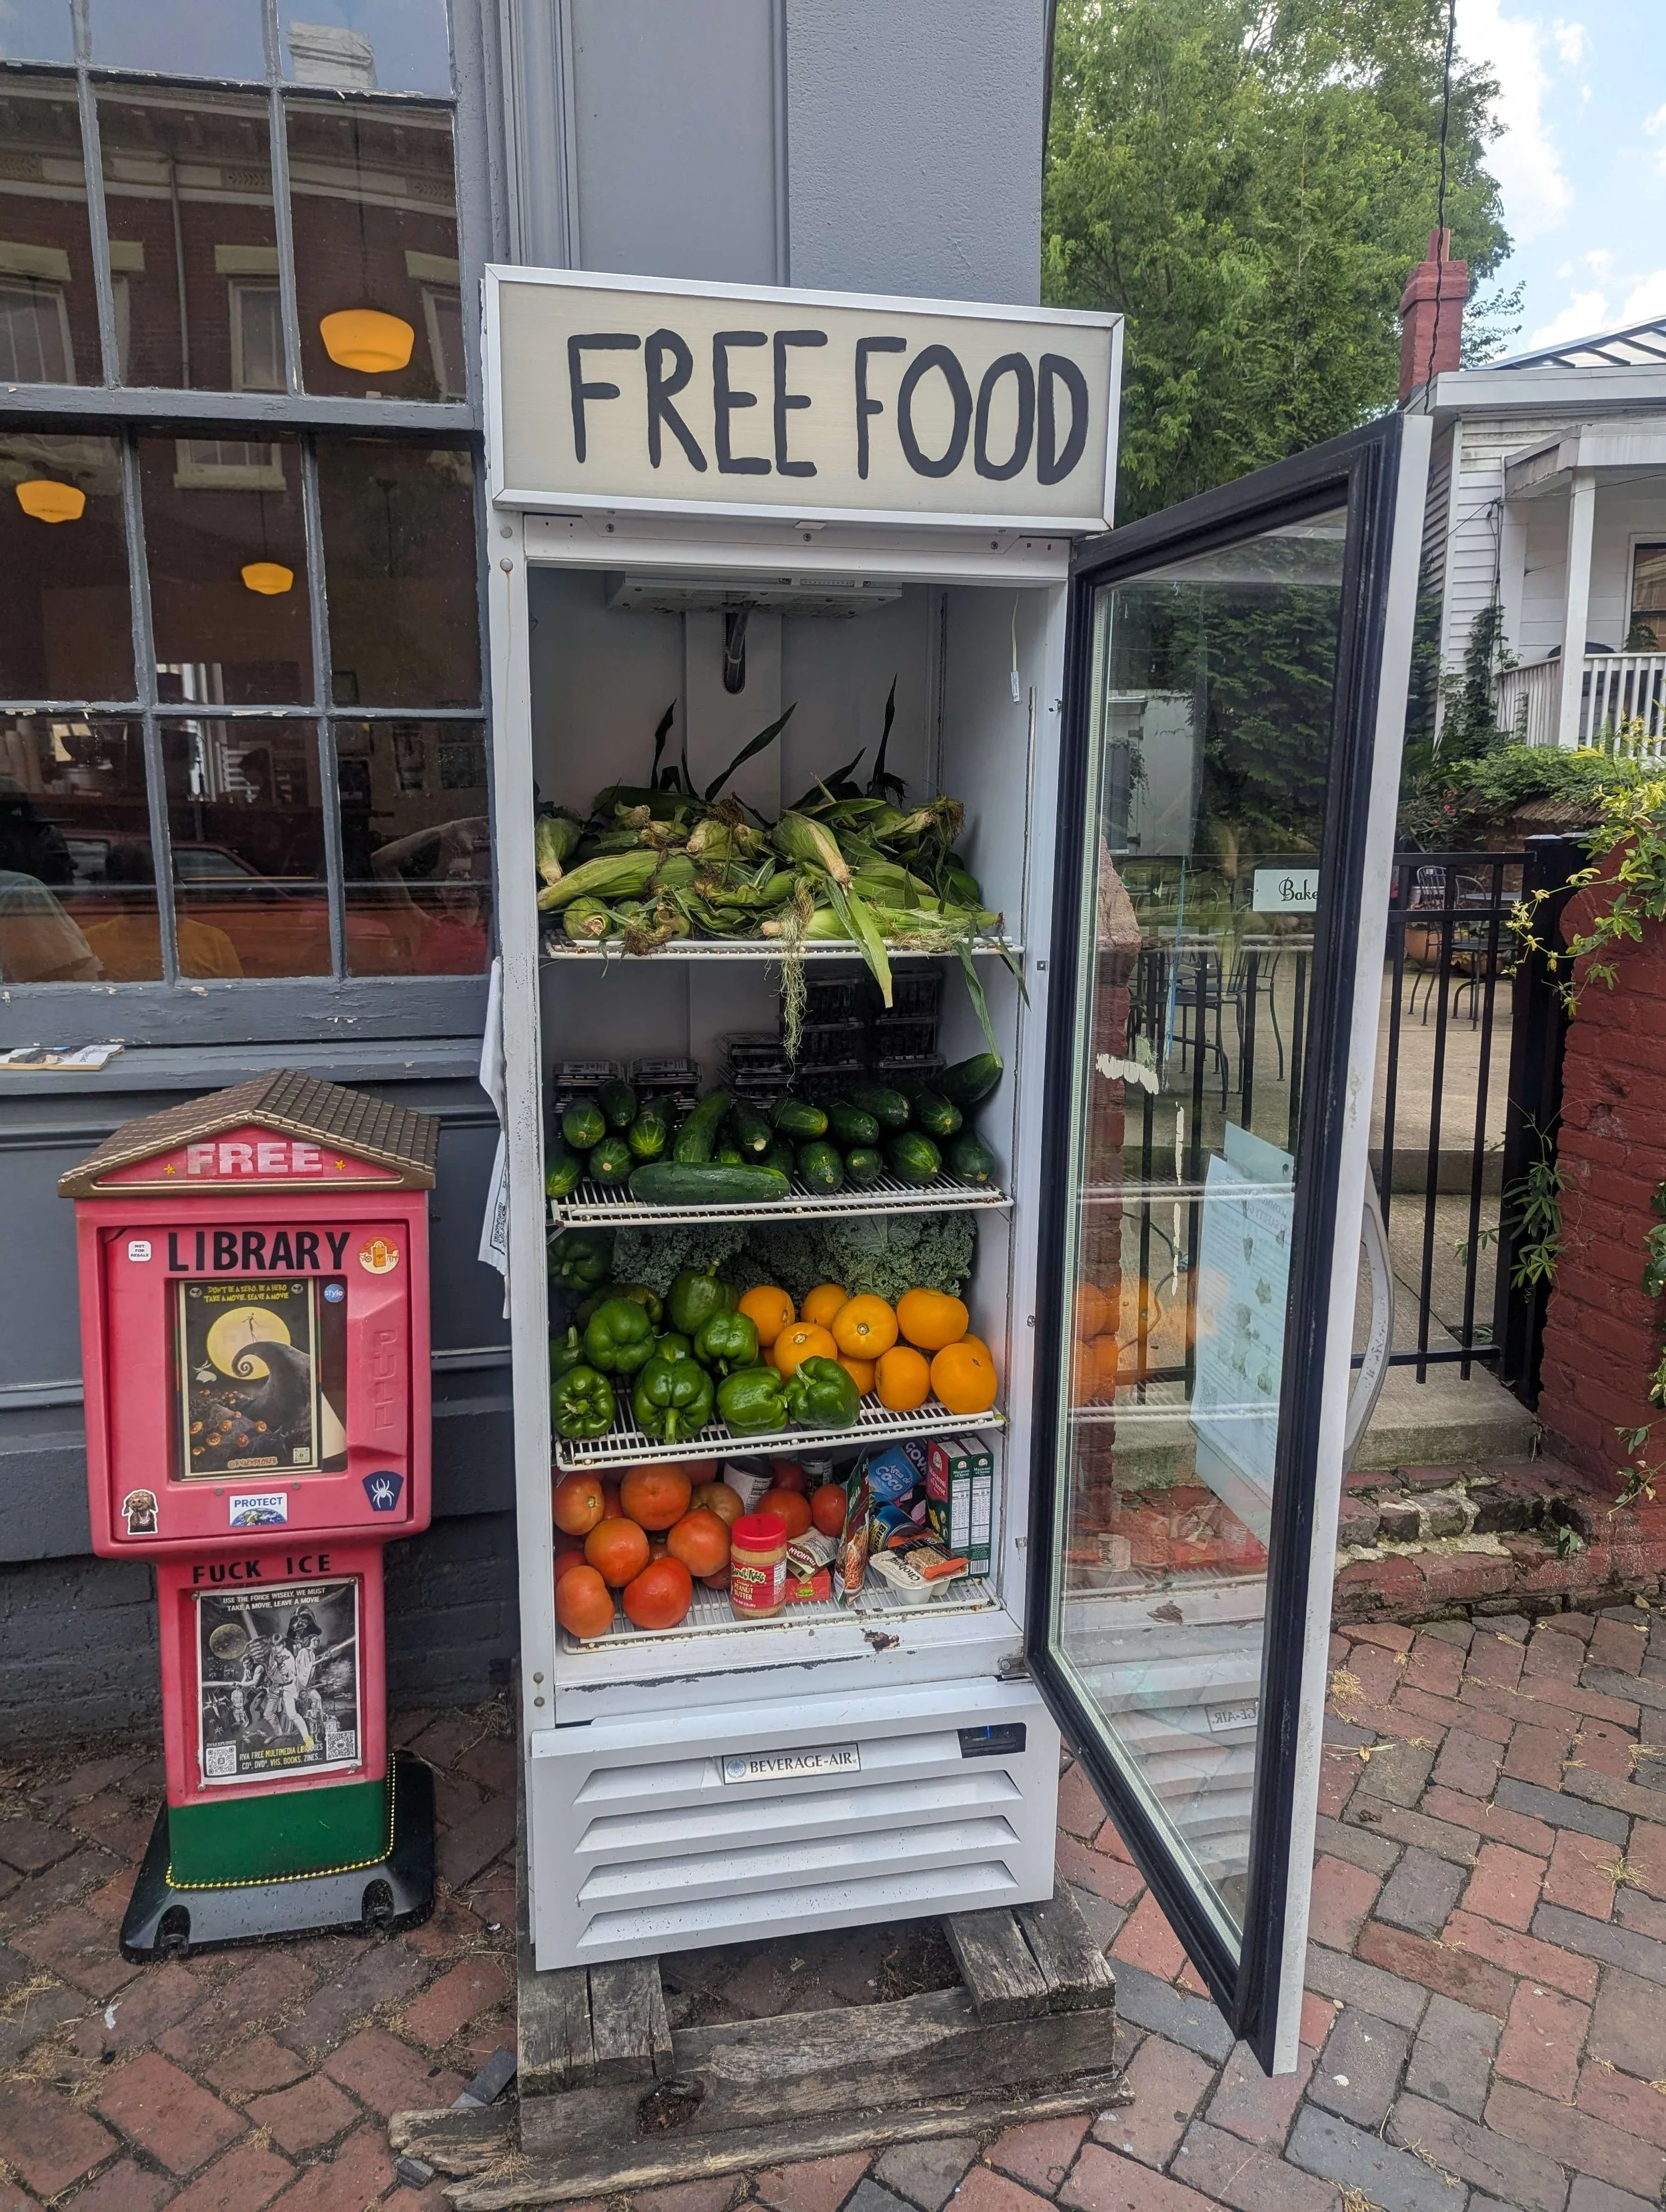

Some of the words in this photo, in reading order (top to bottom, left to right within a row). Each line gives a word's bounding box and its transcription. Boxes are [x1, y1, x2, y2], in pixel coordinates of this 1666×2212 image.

[567, 327, 828, 478] FREE
[855, 336, 1088, 486] FOOD
[187, 1142, 323, 1174] FREE
[168, 1231, 351, 1272] LIBRARY
[373, 1330, 398, 1431] PULL
[235, 1497, 283, 1508] PROTECT
[193, 1560, 261, 1584] FUCK
[287, 1554, 331, 1574] ICE
[734, 1582, 754, 1594] PEANUT
[734, 1588, 752, 1600] BUTTER
[251, 1750, 264, 1759] FREE
[265, 1746, 296, 1758] MULTIMEDIA
[297, 1743, 323, 1754] LIBRARIES
[750, 1752, 852, 1774] BEVERAGE-AIR
